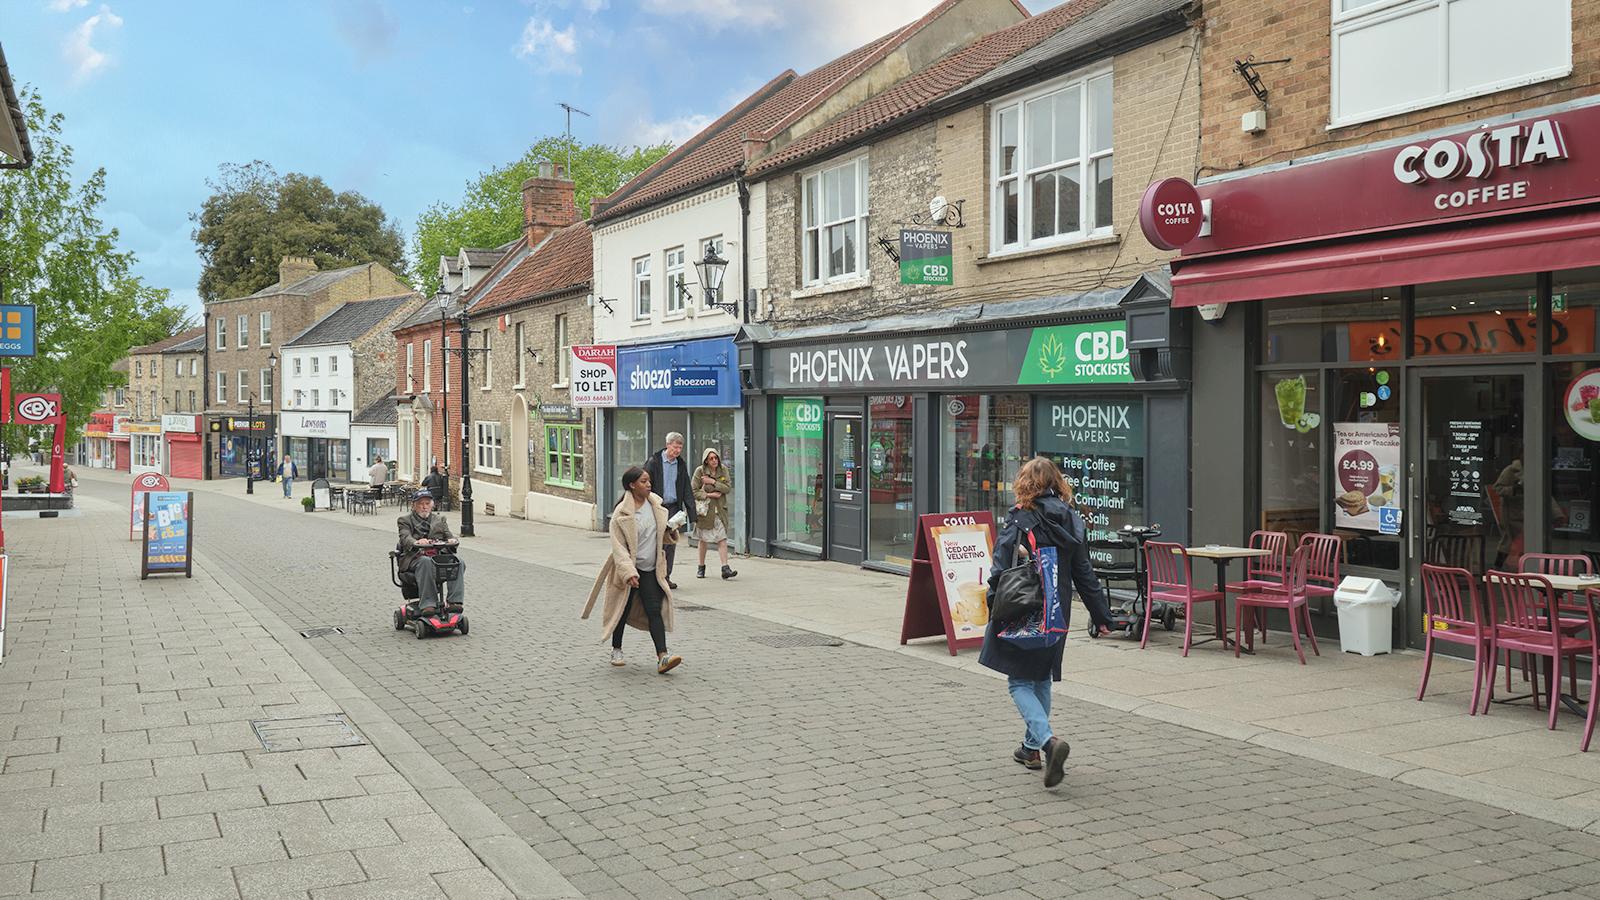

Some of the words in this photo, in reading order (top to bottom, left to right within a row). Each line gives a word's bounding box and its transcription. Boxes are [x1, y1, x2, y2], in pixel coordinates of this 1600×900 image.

[1394, 120, 1567, 184] COSTA
[1434, 181, 1527, 210] COFFEE
[1157, 202, 1195, 217] COSTA
[1164, 217, 1190, 225] COFFEE
[903, 232, 948, 244] PHOENIX
[923, 265, 948, 276] CBD
[1075, 330, 1128, 361] CBD
[790, 347, 874, 383] PHOENIX
[884, 341, 969, 381] VAPERS
[580, 369, 607, 378] SHOP
[1075, 362, 1130, 376] STOCKISTS
[630, 365, 686, 390] shoezo
[674, 377, 716, 386] shoezone
[575, 381, 590, 392] TO
[593, 381, 614, 391] LET
[796, 404, 820, 422] CBD
[1052, 405, 1130, 429] PHOENIX
[301, 416, 327, 429] Lawsons
[796, 422, 820, 431] STOCKISTS
[1070, 430, 1111, 442] VAPERS
[1372, 439, 1400, 447] Teacake
[1063, 457, 1082, 469] Free
[1084, 458, 1116, 471] Coffee
[1343, 459, 1374, 471] £4.99
[1082, 475, 1120, 493] Gaming
[1074, 493, 1124, 509] Compliant
[943, 516, 976, 527] COSTA
[946, 551, 985, 560] VELVETINO
